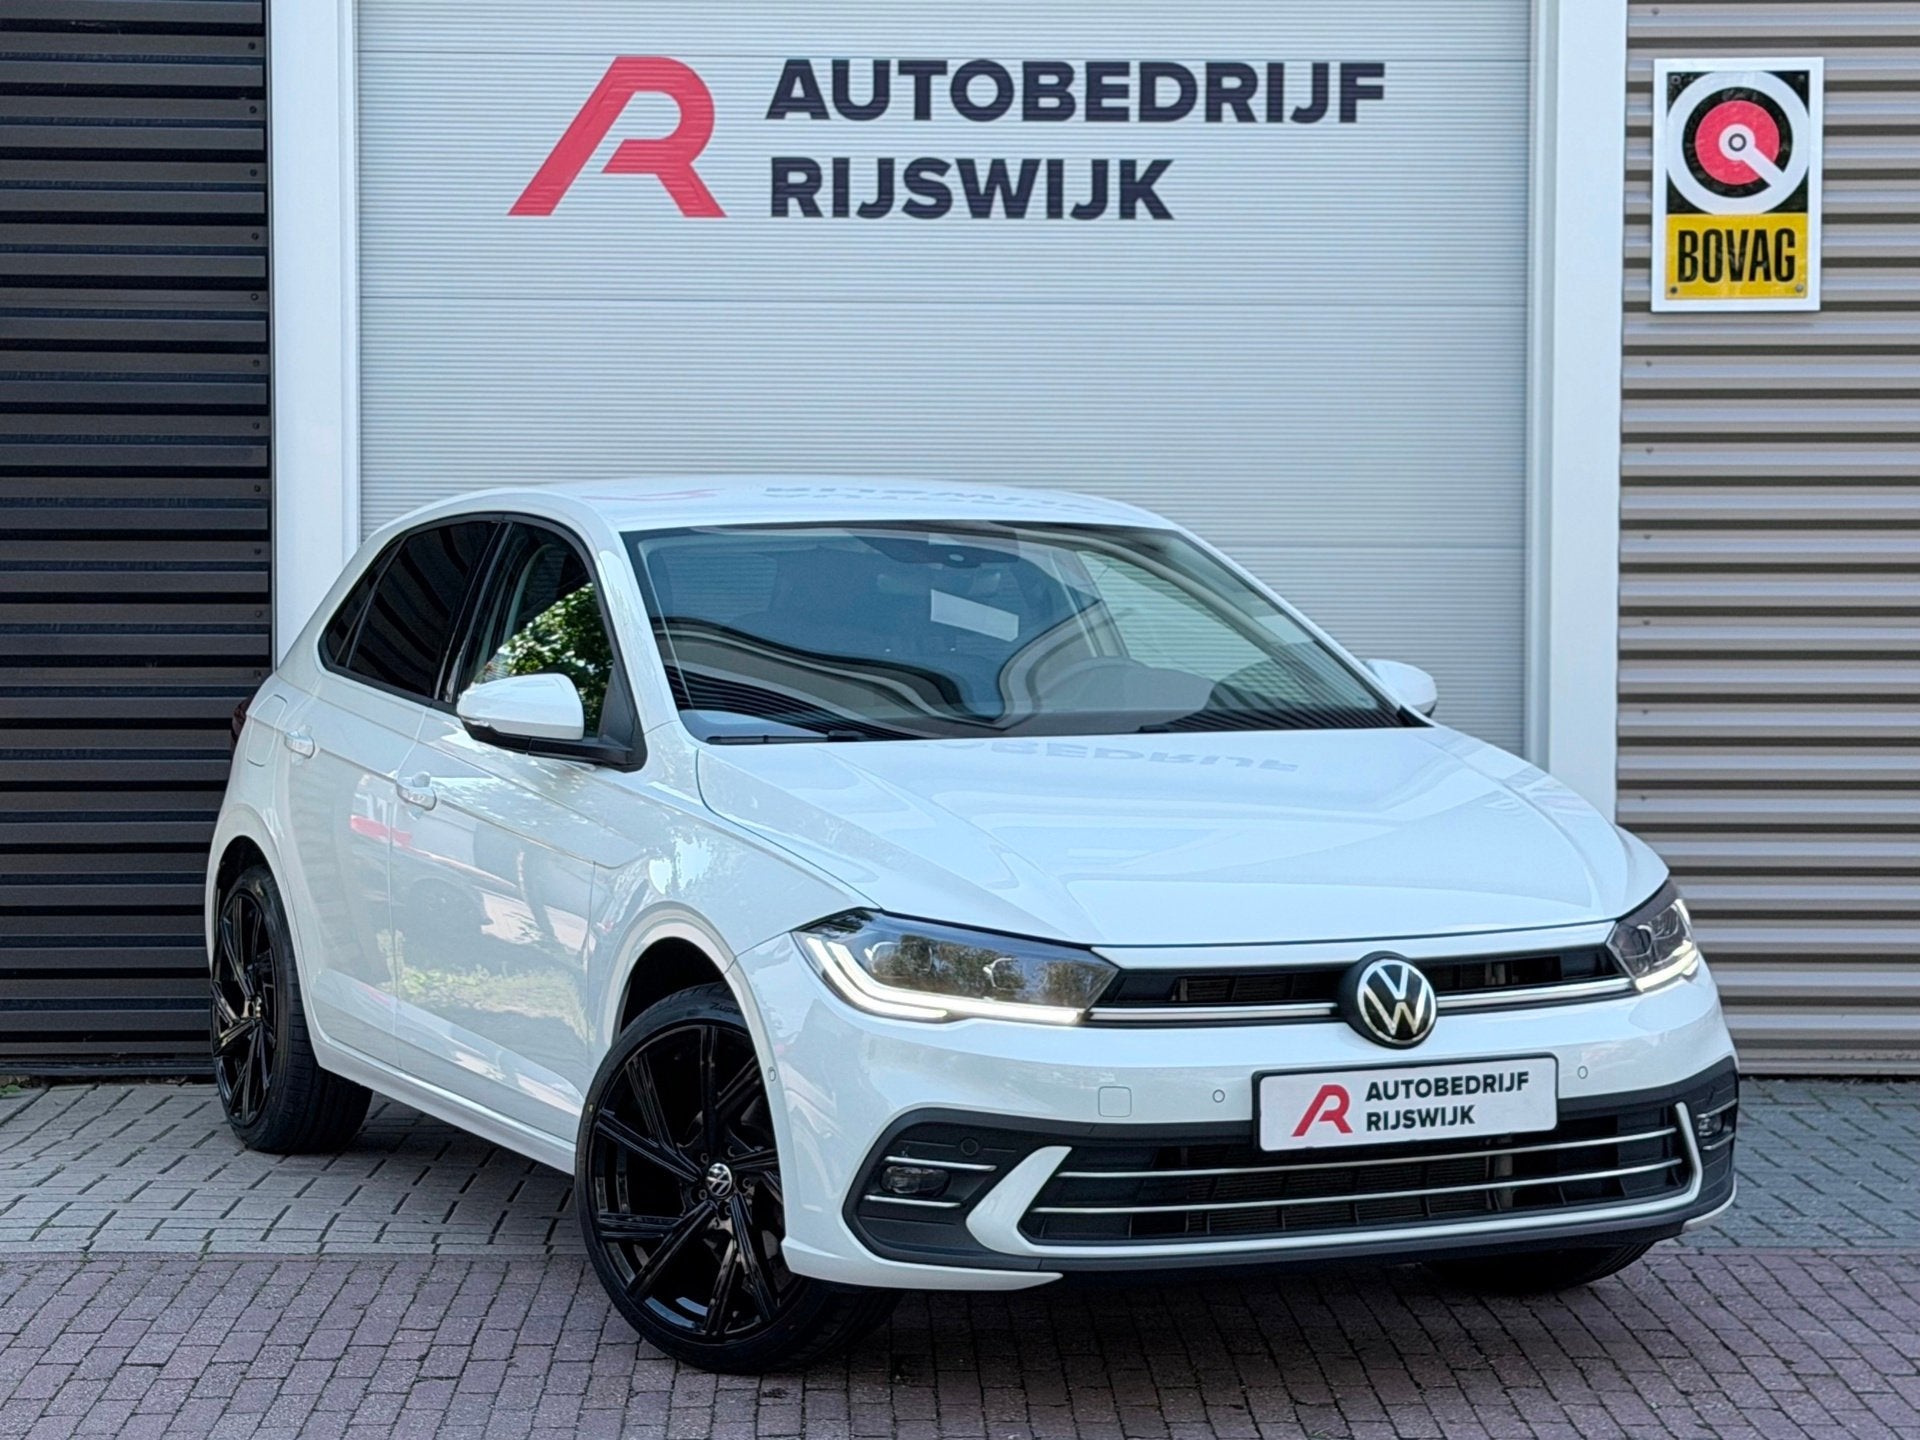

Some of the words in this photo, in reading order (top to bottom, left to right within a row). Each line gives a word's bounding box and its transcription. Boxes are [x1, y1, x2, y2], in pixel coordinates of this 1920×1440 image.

[766, 59, 1386, 124] AUTOBEDRIJF
[770, 156, 1175, 221] RIJSWIJK
[1677, 228, 1796, 283] BOVAG
[1365, 1071, 1530, 1102] AUTOBEDRIJF
[1366, 1105, 1476, 1132] RIJSWIJK
